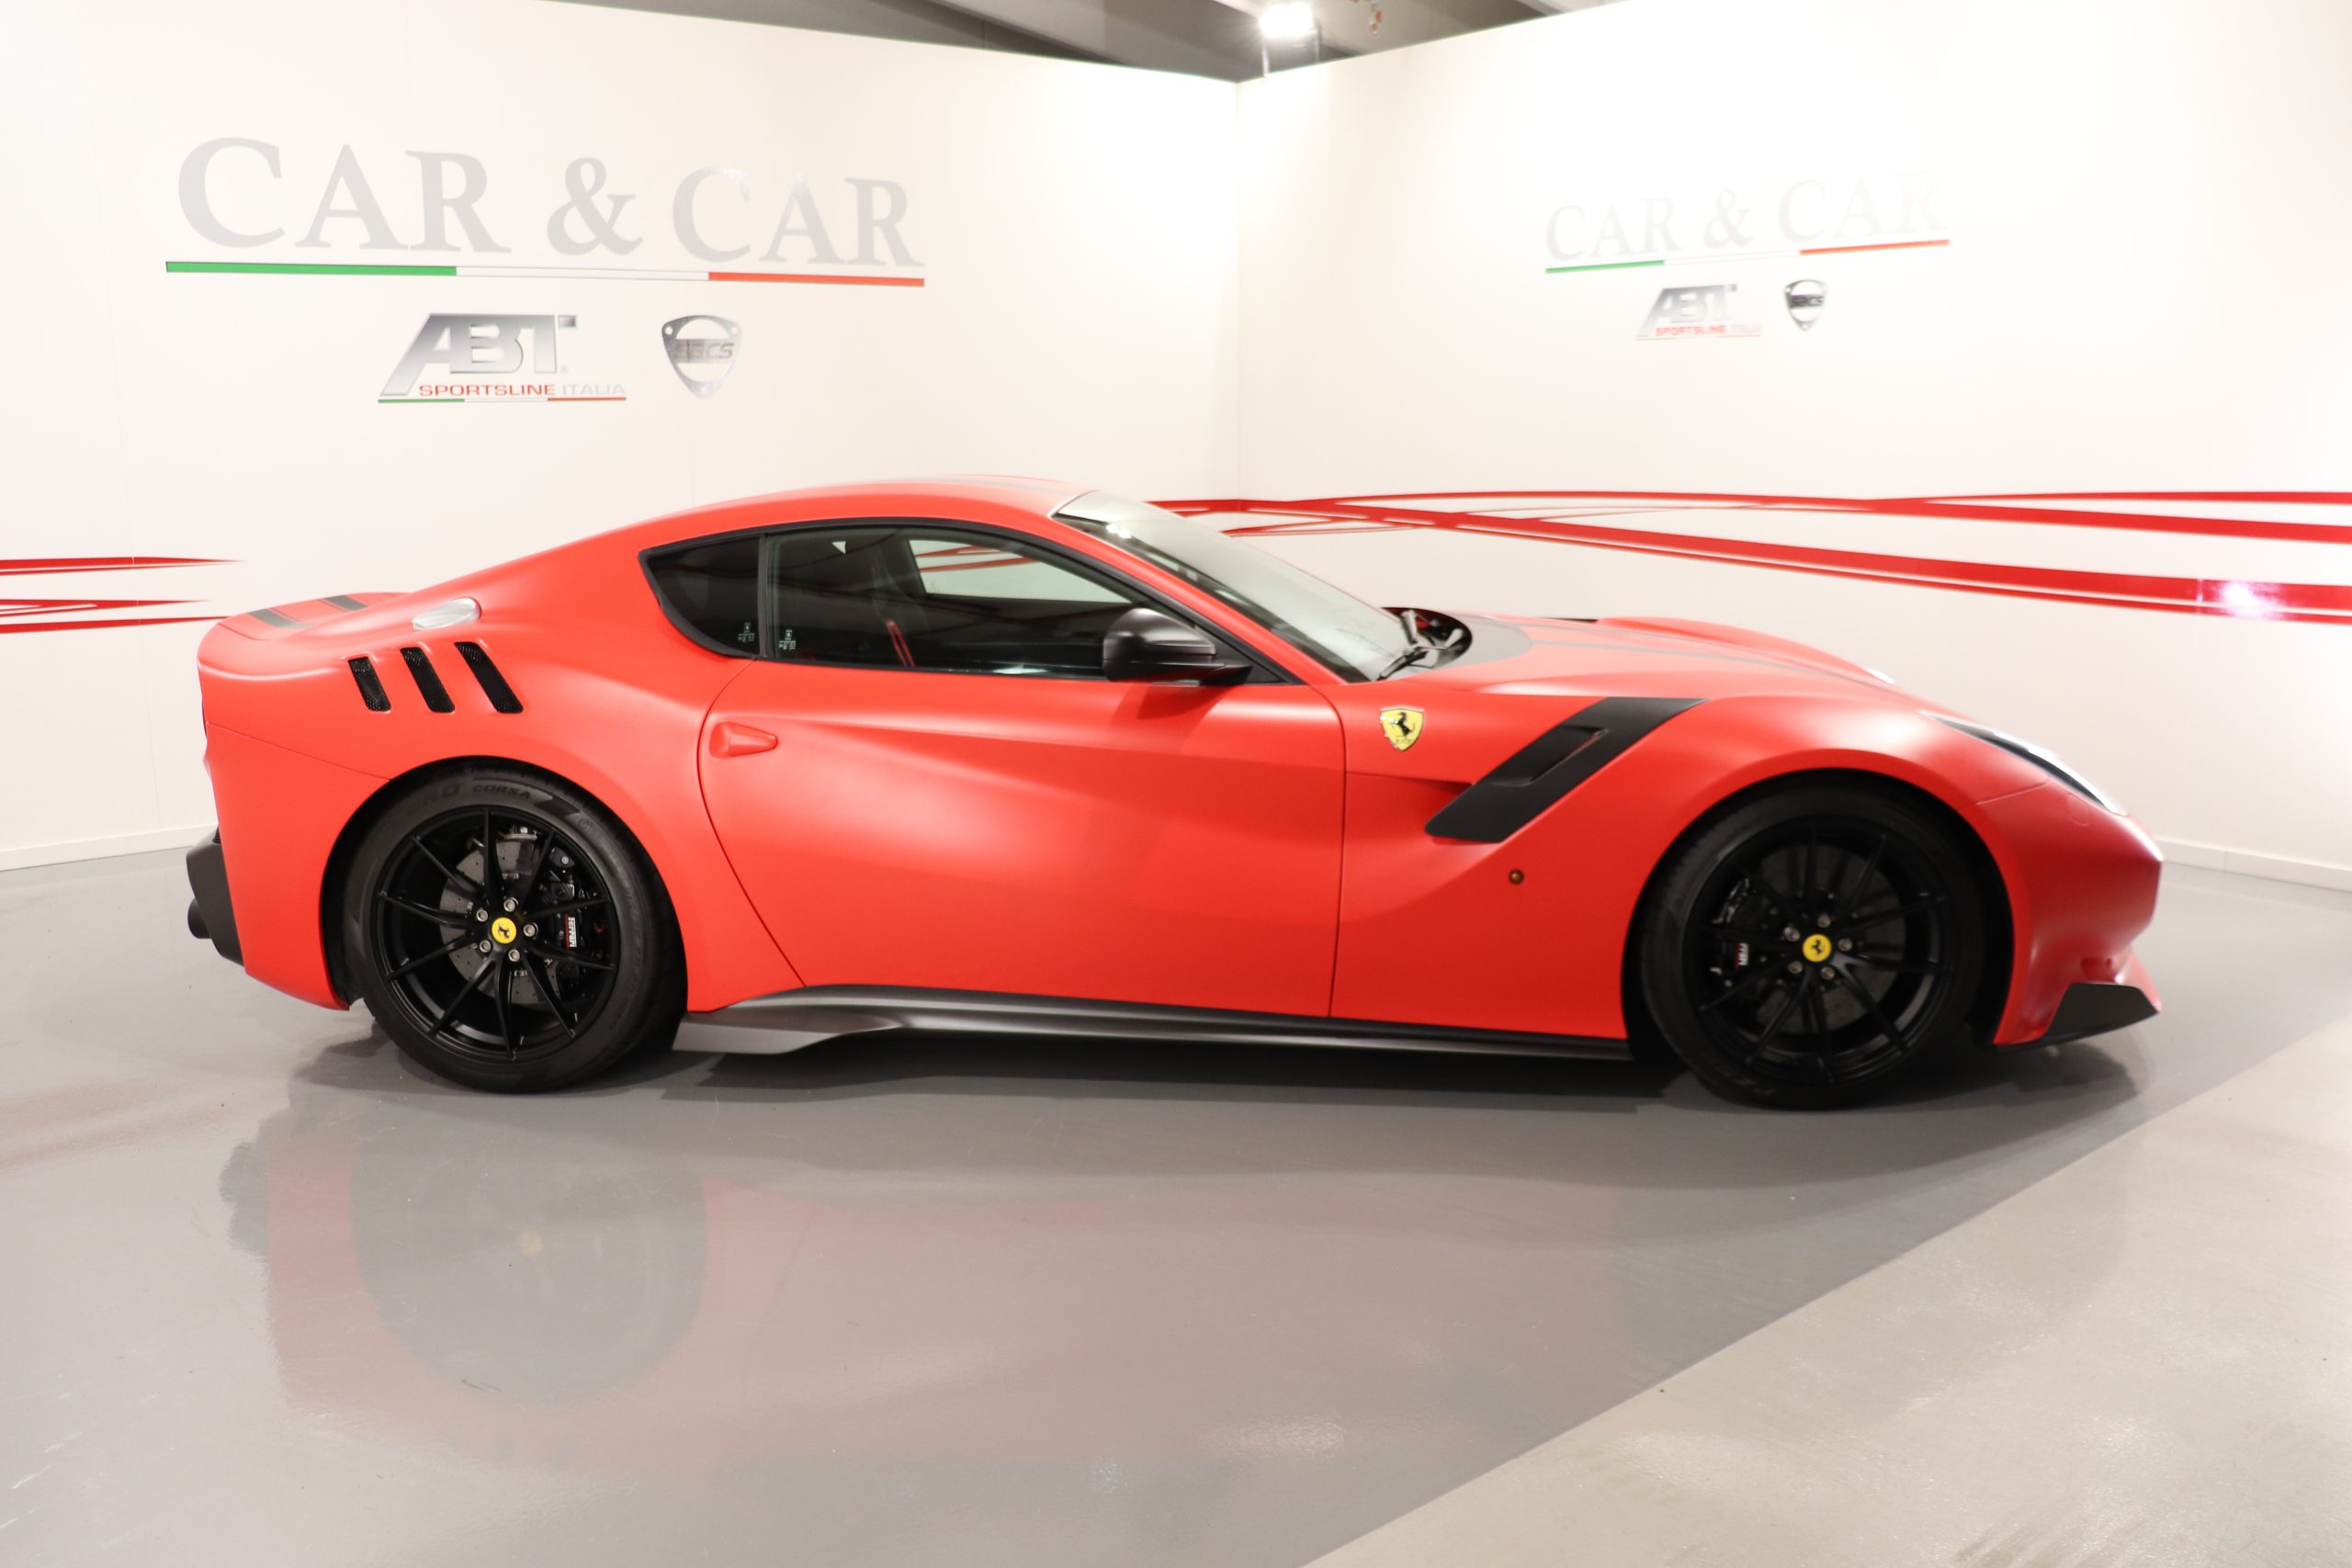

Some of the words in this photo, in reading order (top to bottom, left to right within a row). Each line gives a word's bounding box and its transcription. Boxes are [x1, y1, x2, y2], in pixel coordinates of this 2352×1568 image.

[178, 137, 512, 254] CAR
[546, 157, 643, 255] &
[672, 167, 925, 266] CAR
[1544, 197, 1684, 261] CAR
[1703, 188, 1755, 249] &
[1778, 169, 1951, 241] CAR
[1636, 285, 1726, 336] ABT
[1656, 324, 1726, 335] SPORTSLINE
[379, 313, 558, 397] ABT
[419, 384, 556, 397] SPORTSLINE
[562, 383, 626, 395] ITALIA
[473, 784, 532, 799] CORSA
